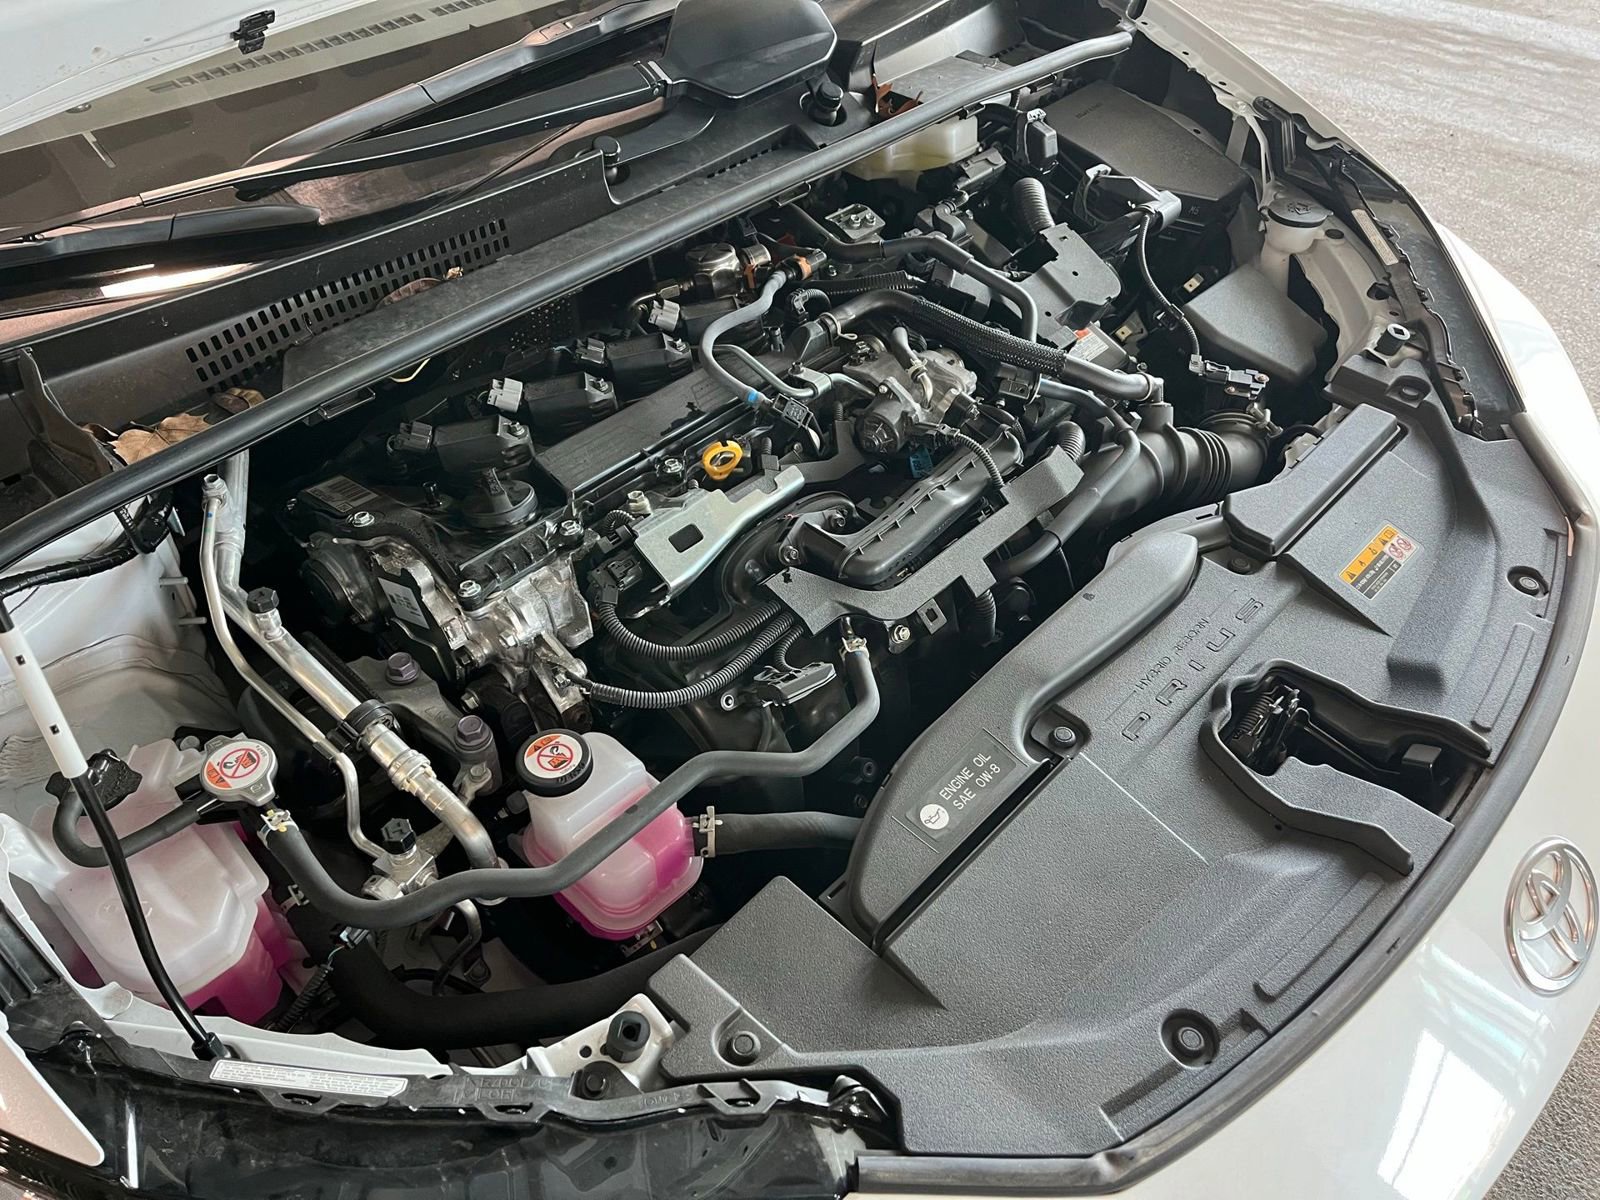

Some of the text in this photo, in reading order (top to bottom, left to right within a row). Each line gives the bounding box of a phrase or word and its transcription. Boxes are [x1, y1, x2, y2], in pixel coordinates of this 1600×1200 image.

[1121, 597, 1264, 742] PRIUS
[1135, 656, 1172, 690] HYBRID
[939, 753, 991, 800] ENGINE OIL
[953, 763, 1001, 809] SAE 0W-8
